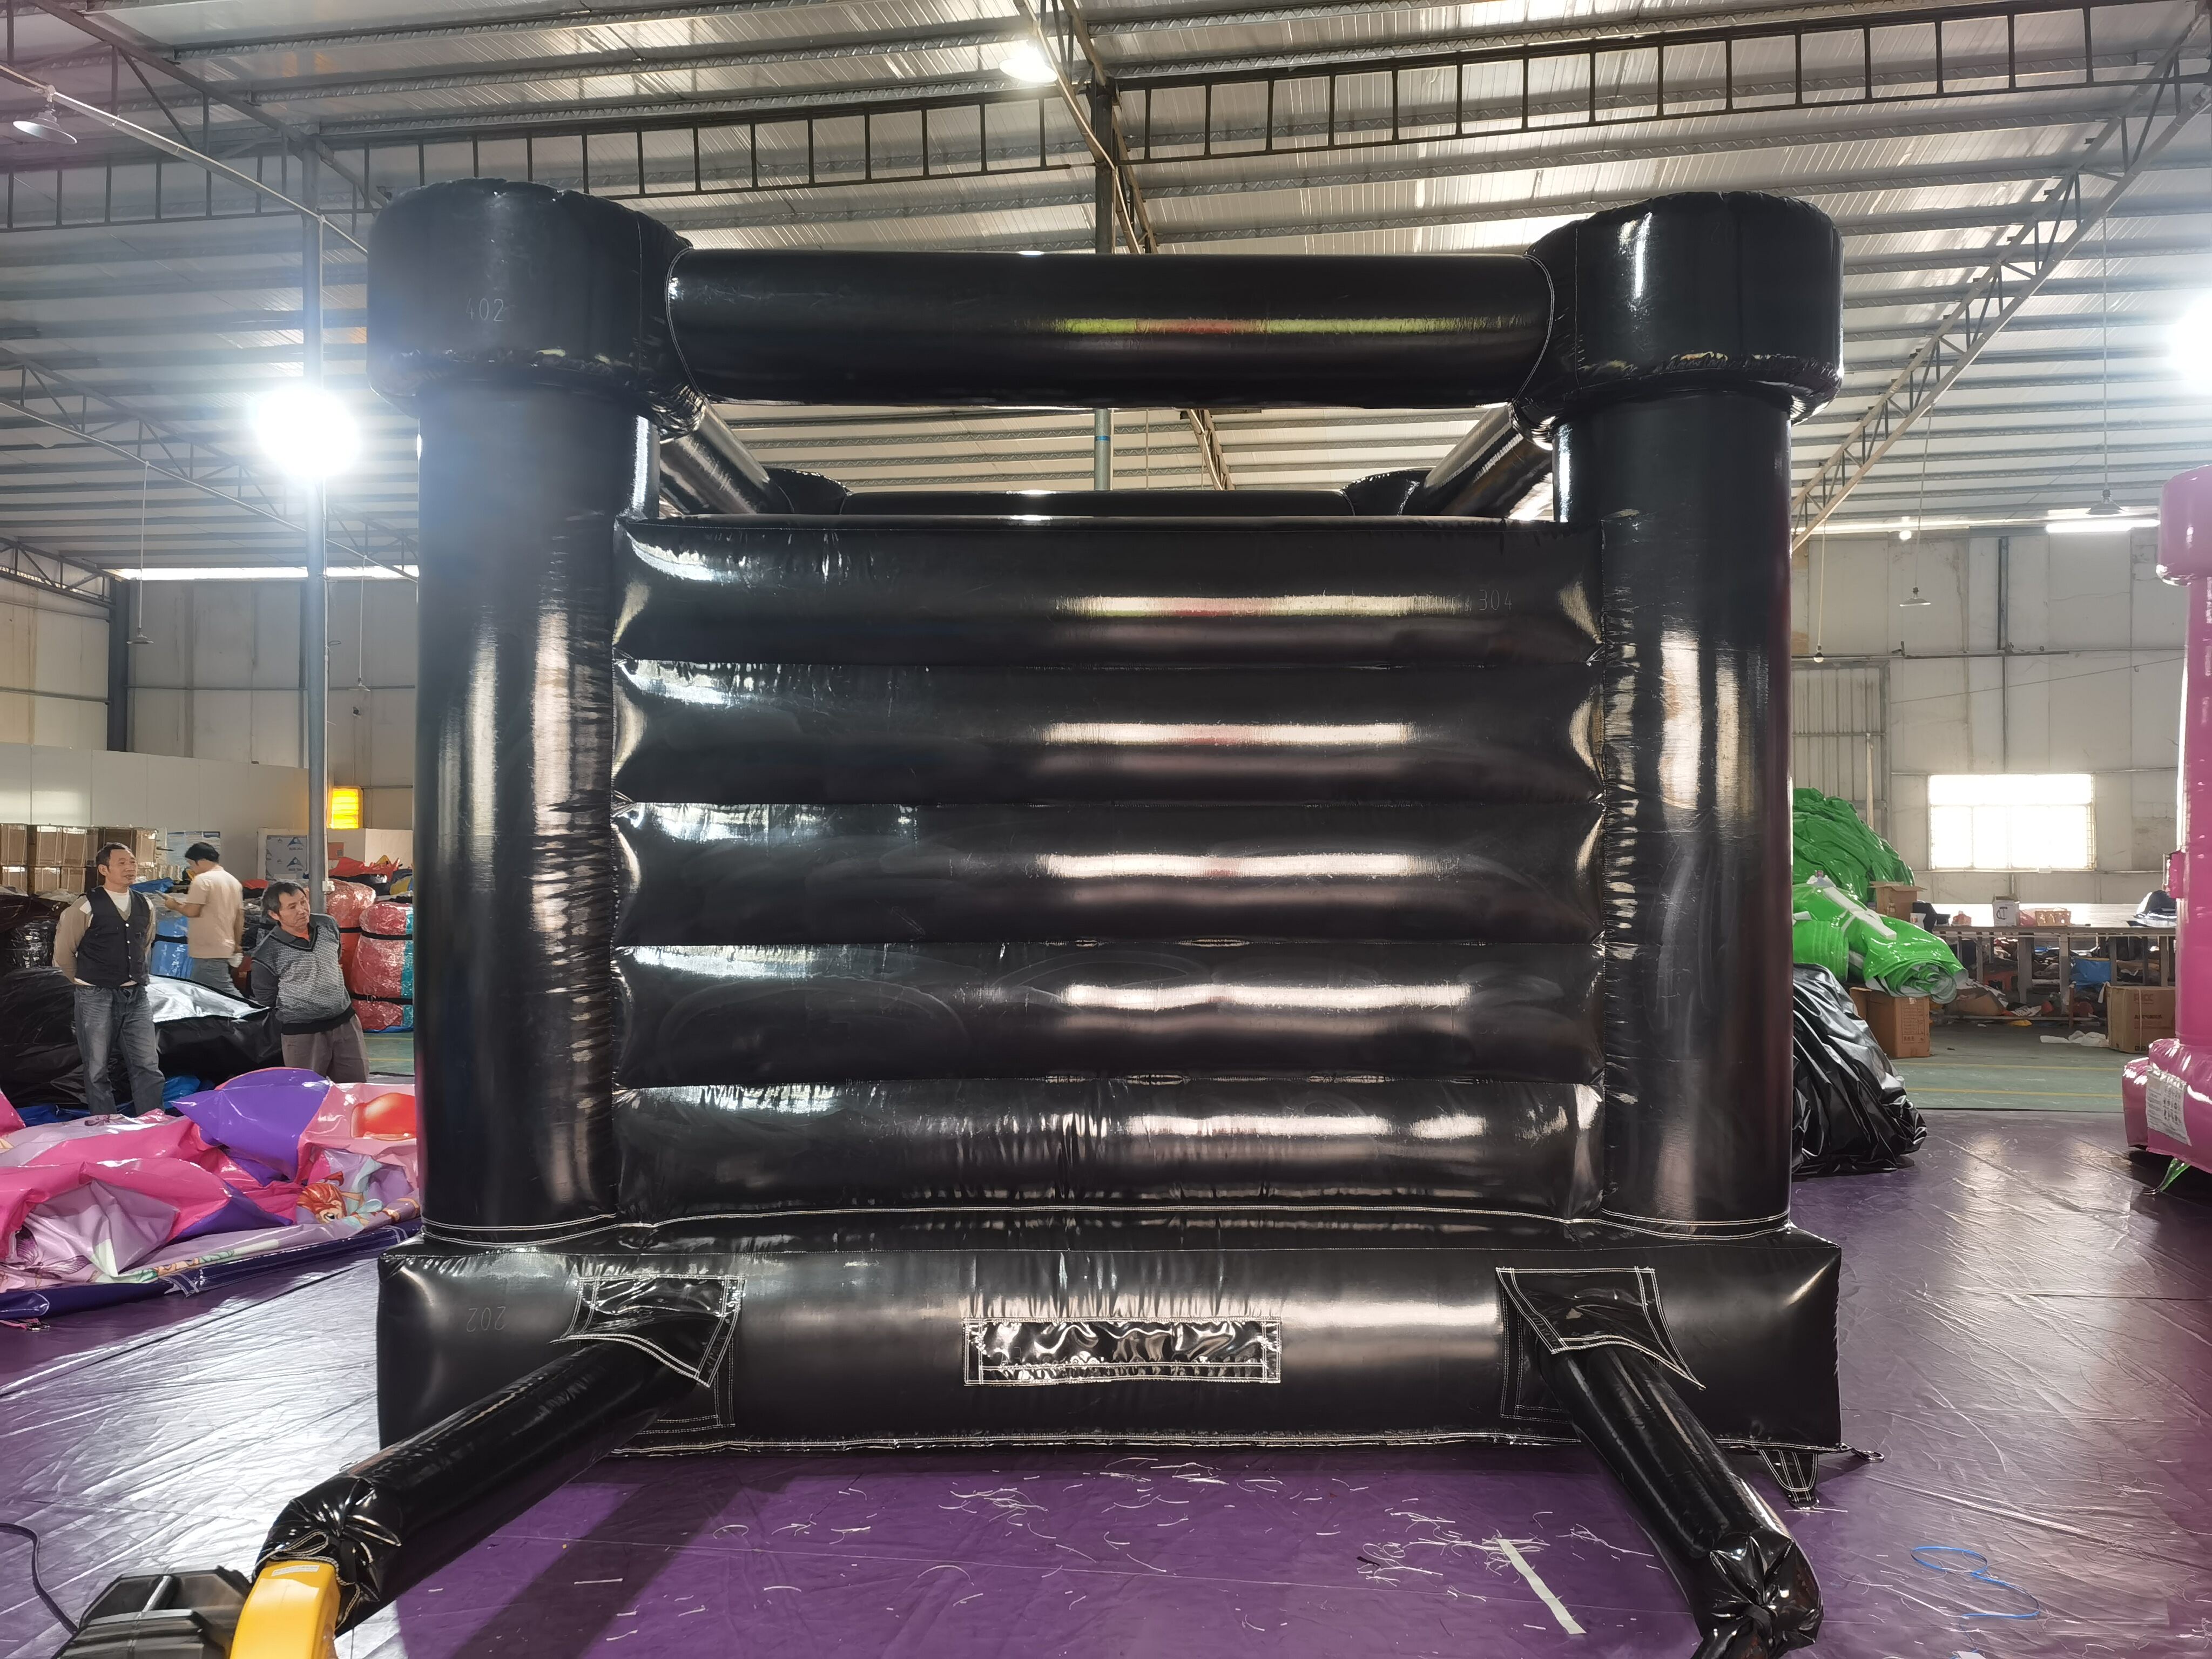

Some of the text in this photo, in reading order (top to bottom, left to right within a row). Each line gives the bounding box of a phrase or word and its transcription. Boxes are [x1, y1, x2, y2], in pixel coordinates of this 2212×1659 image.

[467, 298, 504, 321] 402
[1478, 589, 1513, 610] 304
[466, 1306, 507, 1332] 202
